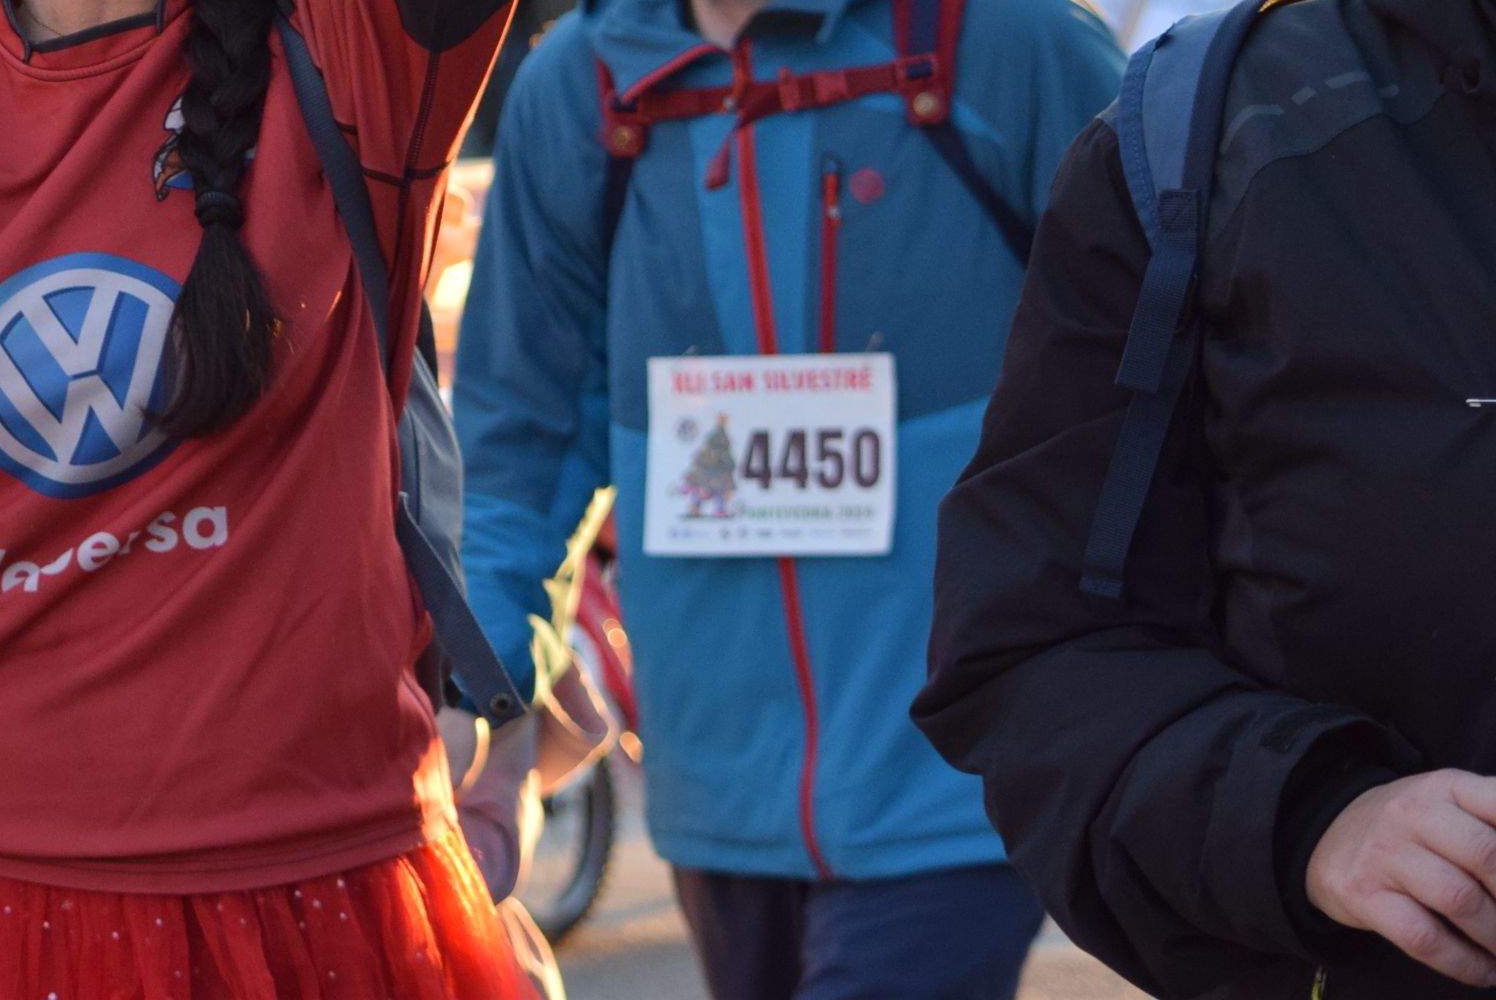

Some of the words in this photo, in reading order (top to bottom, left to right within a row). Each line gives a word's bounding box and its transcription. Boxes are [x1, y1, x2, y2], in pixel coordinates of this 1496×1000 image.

[712, 371, 755, 393] SAN
[763, 367, 874, 393] SILVESTRE
[743, 429, 882, 490] 4450
